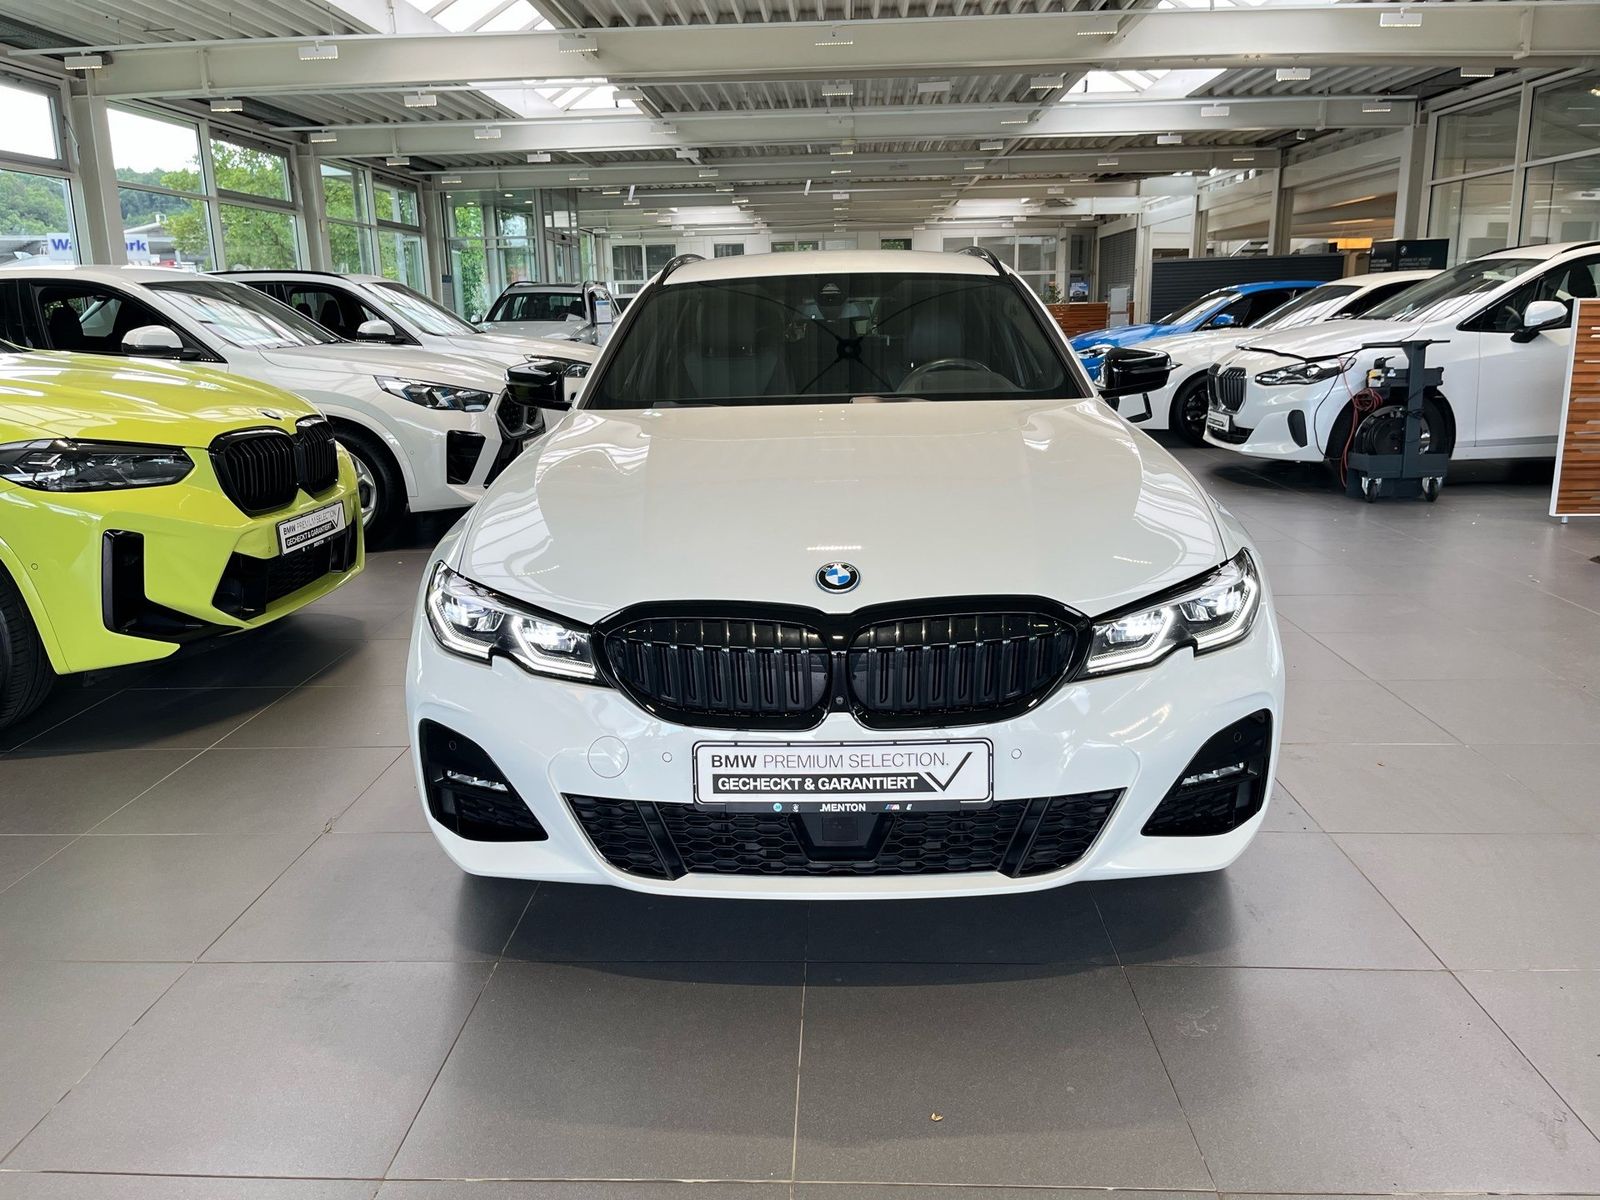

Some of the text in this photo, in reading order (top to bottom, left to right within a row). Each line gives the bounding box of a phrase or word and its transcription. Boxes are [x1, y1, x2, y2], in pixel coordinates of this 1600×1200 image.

[283, 525, 295, 535] BMW
[711, 754, 758, 769] BMW
[763, 753, 844, 769] PREMIUM
[717, 775, 918, 791] GECHECKT & GARANTIERT
